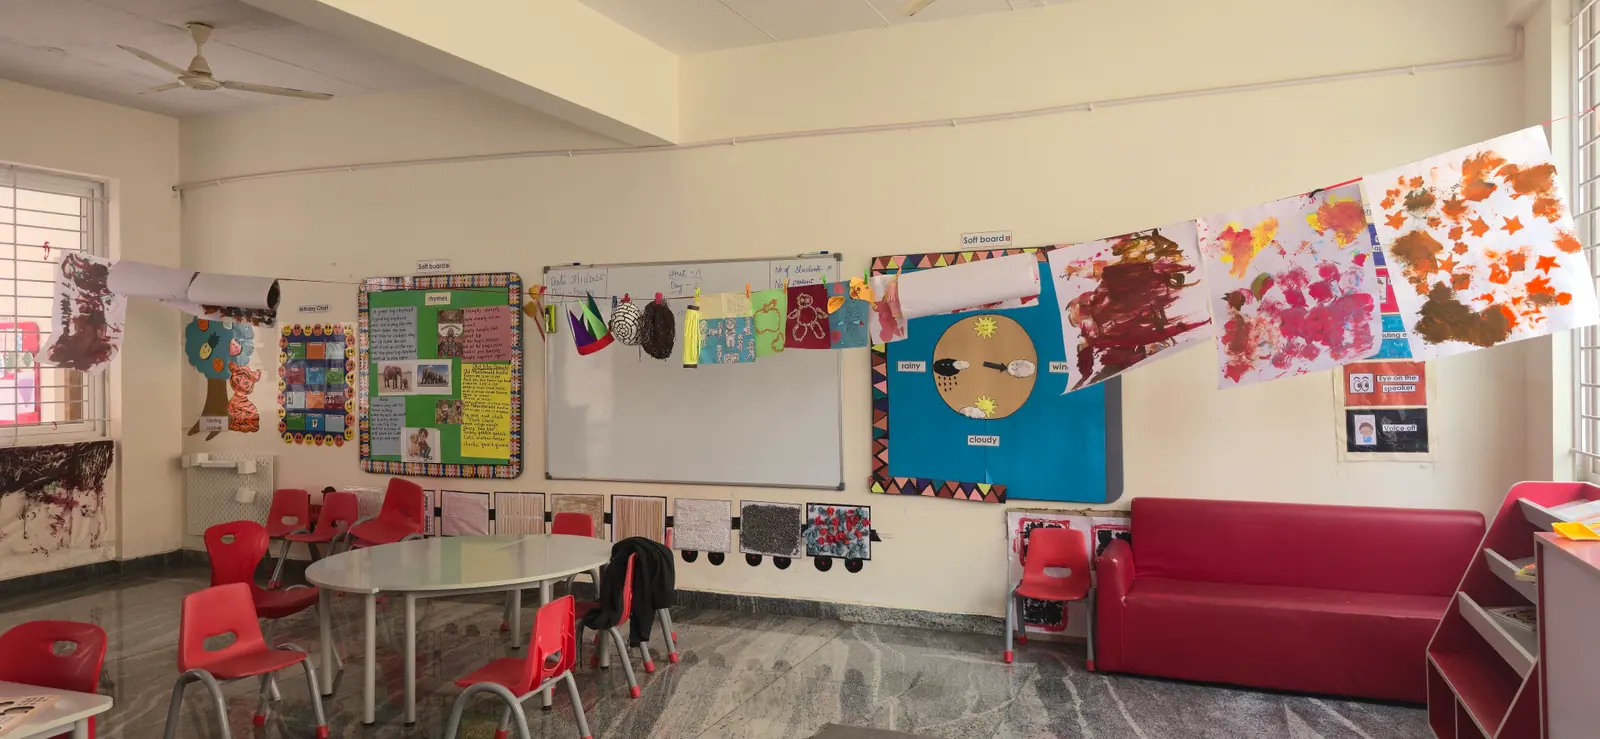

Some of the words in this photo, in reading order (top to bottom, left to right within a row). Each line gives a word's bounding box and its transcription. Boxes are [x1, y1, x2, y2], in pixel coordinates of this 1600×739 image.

[963, 236, 978, 244] Soft
[980, 235, 1004, 243] board
[902, 362, 921, 370] rainy
[1384, 385, 1413, 393] speaker
[969, 436, 997, 444] cloudy
